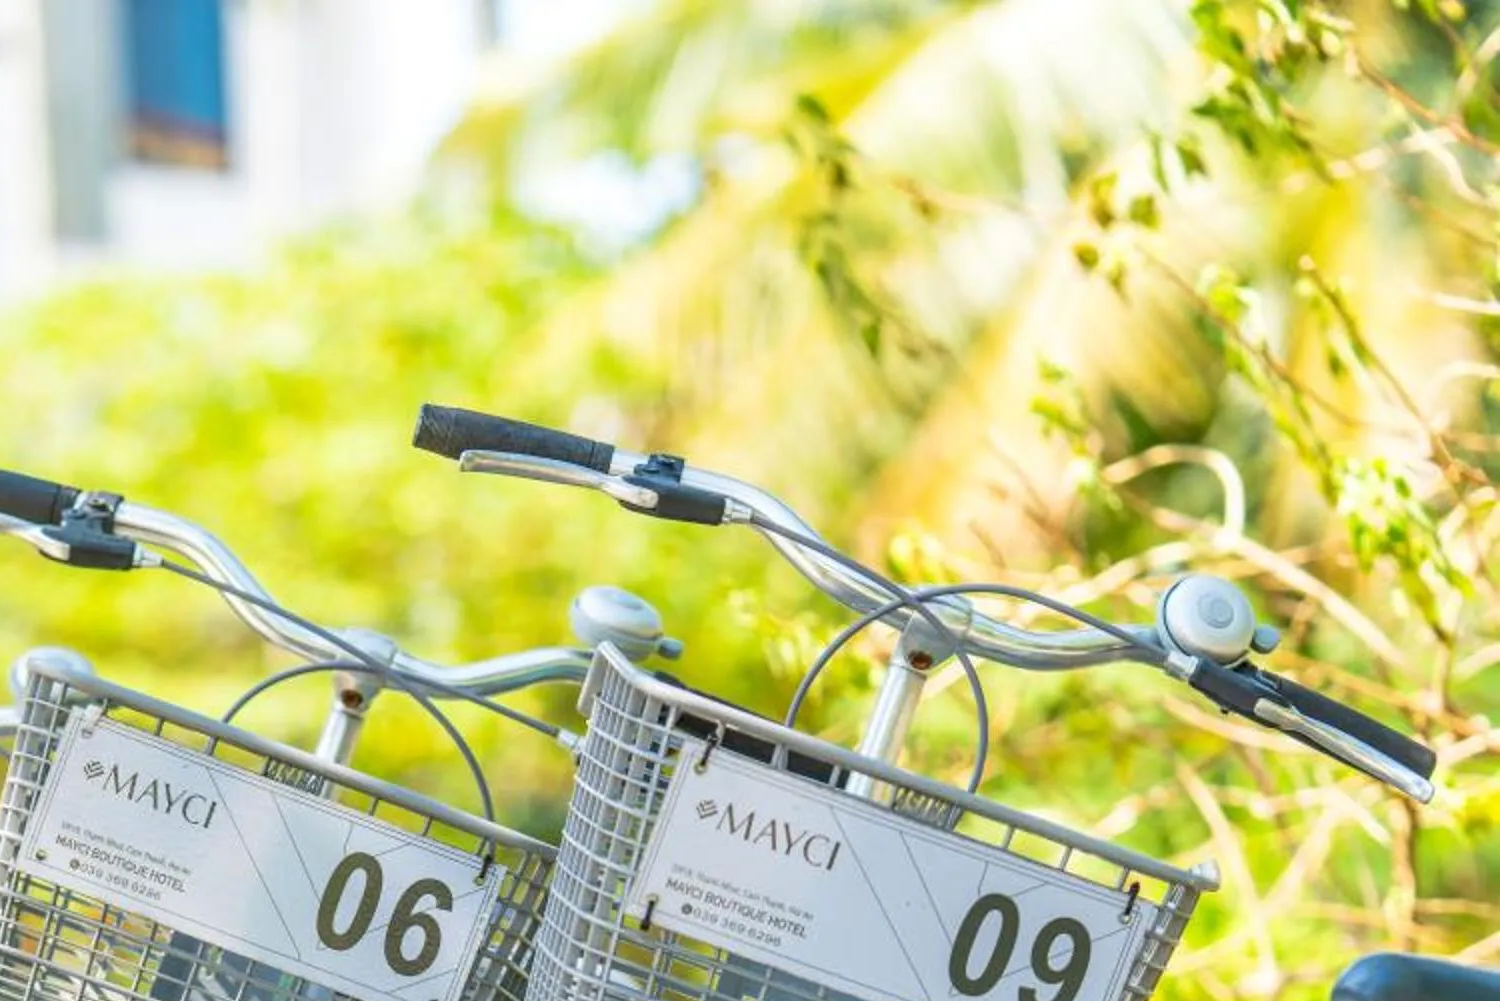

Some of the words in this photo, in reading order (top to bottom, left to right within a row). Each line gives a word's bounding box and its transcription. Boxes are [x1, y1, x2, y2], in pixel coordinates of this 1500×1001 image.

[102, 764, 217, 829] MAYCI
[55, 834, 91, 856] MAYCI
[91, 847, 150, 878] BOUTIQUE
[149, 869, 186, 893] HOTEL
[715, 803, 841, 871] MAYCI
[317, 853, 453, 976] 06
[665, 877, 704, 901] MAYCI
[704, 891, 769, 922] BOUTIQUE
[767, 910, 806, 938] HOTEL
